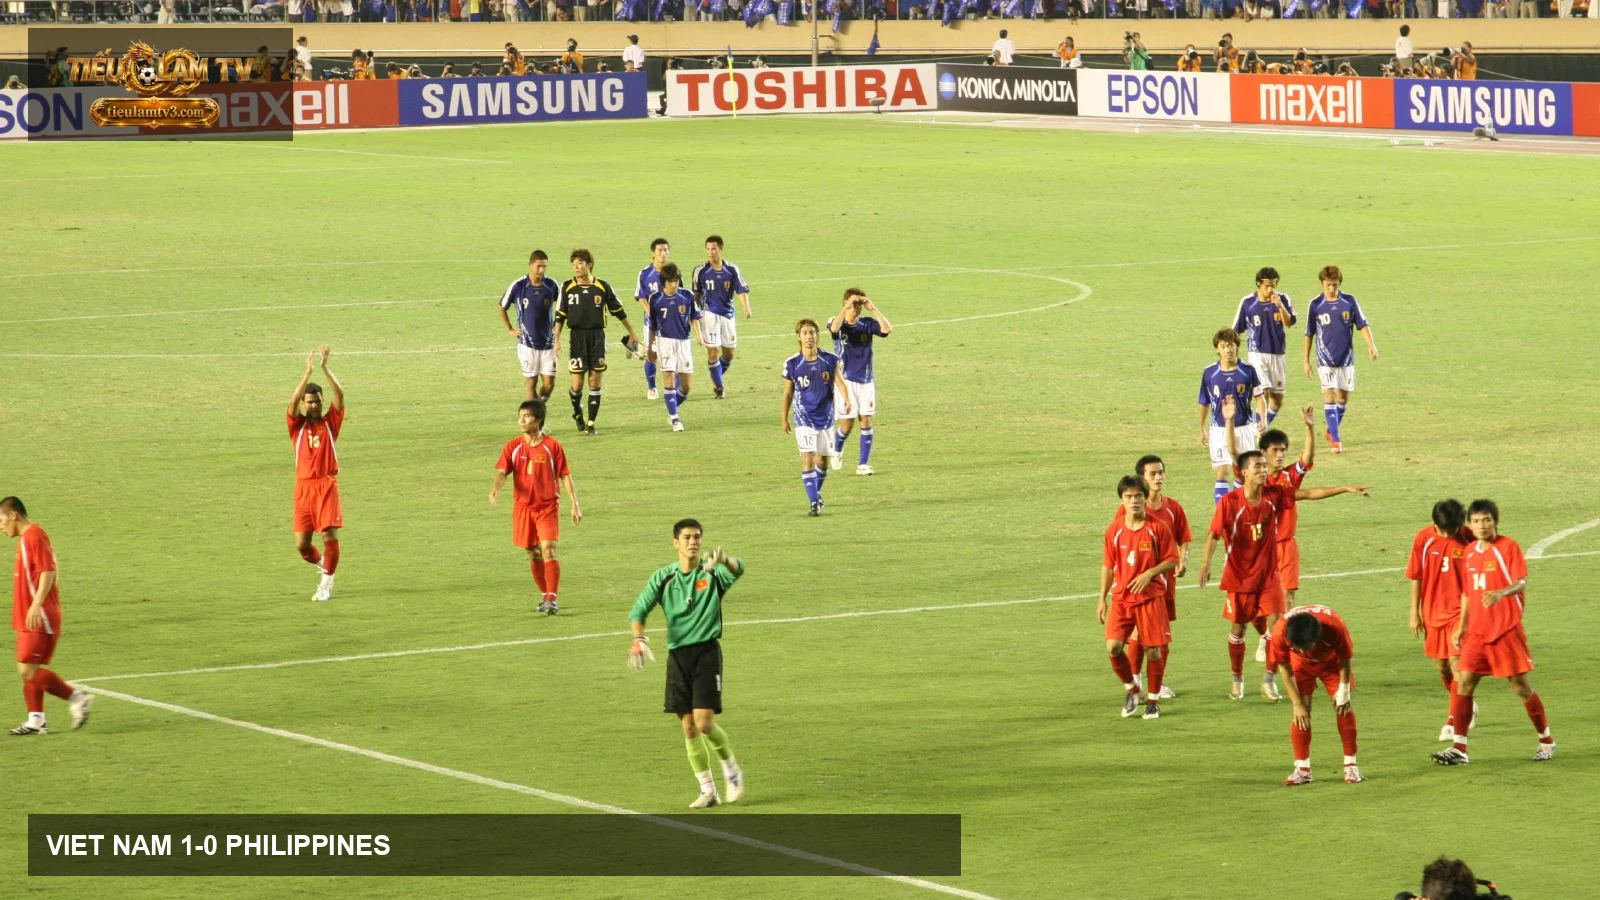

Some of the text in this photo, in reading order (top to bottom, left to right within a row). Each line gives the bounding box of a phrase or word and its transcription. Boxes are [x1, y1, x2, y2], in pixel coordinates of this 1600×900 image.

[676, 68, 928, 112] TOSHIBA
[957, 76, 1076, 103] KONICA MINOLTA
[1107, 74, 1198, 116] EPSON
[421, 78, 625, 119] SAMSUNG
[1259, 80, 1363, 124] maxell
[1409, 84, 1556, 128] SAMSUNG
[705, 280, 715, 291] 11
[522, 297, 530, 309] 9
[567, 293, 580, 305] 21
[660, 307, 669, 319] 7
[1253, 315, 1261, 327] 8
[1318, 313, 1331, 326] 10
[570, 357, 583, 368] 21
[797, 375, 811, 388] 16
[1126, 550, 1136, 567] 4
[1441, 556, 1450, 573] 3
[1472, 572, 1486, 591] 14
